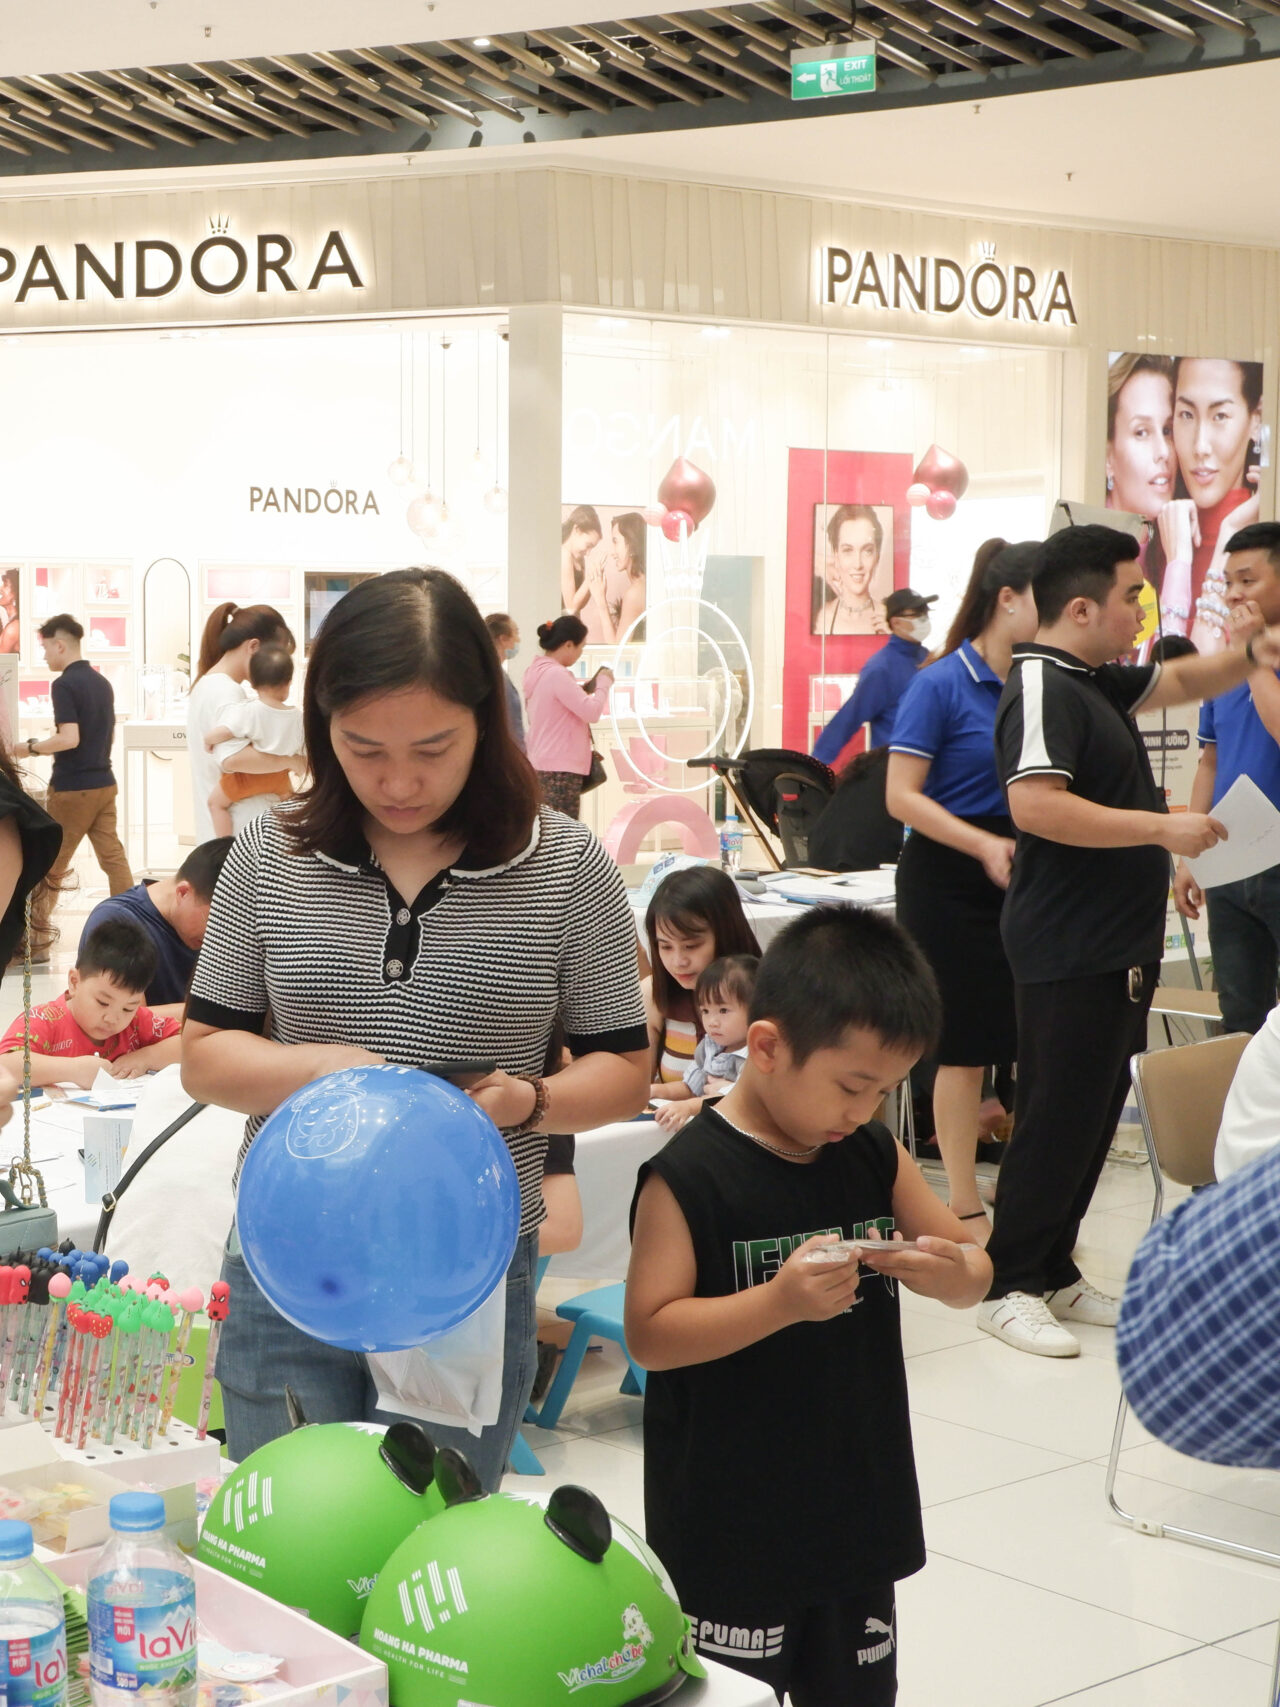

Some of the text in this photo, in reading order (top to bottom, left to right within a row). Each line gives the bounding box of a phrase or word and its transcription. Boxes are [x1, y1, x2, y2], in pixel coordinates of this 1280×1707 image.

[843, 59, 868, 71] EXIT
[823, 246, 1078, 326] PANDORA
[250, 480, 380, 515] PANDORA
[228, 1542, 267, 1569] PHARMA
[699, 1620, 766, 1651] PUMA
[374, 1627, 469, 1674] HOANG HA PHARMA
[857, 1639, 892, 1666] PUMA
[409, 1659, 424, 1671] FOR
[427, 1666, 445, 1679] LIFE
